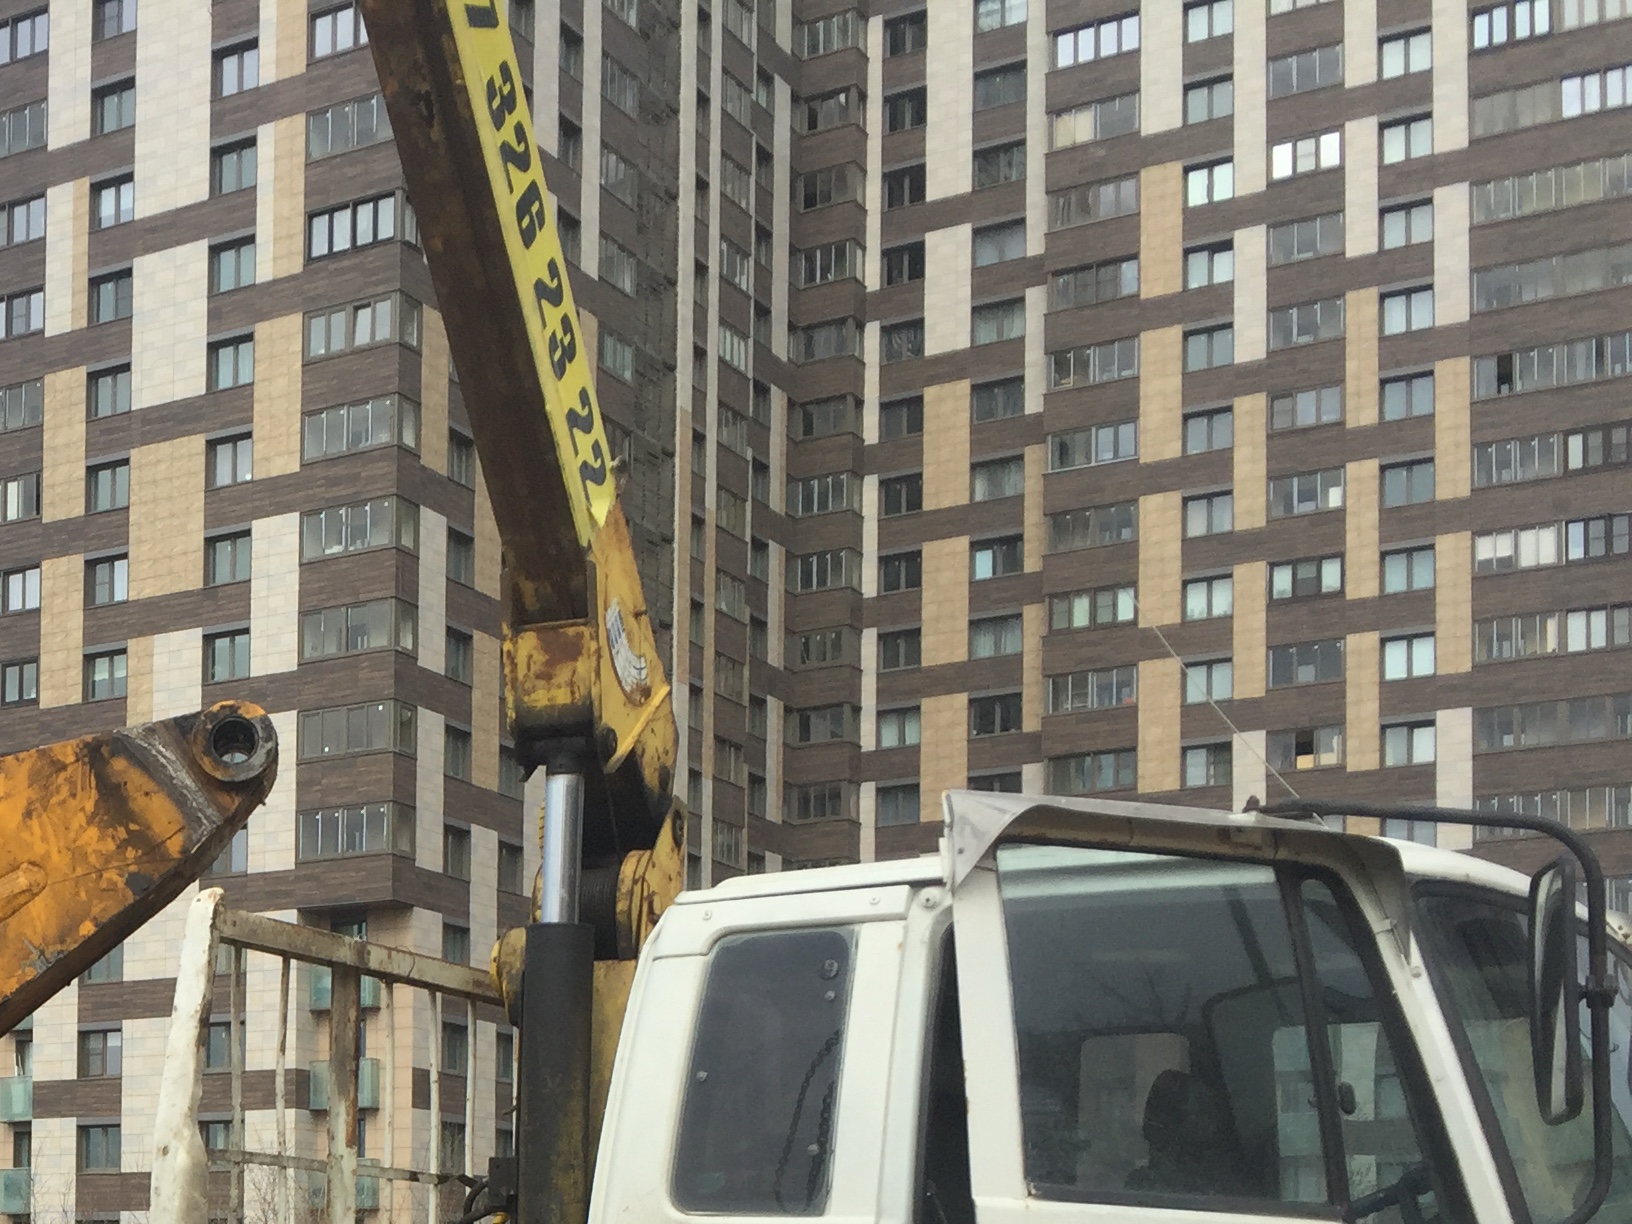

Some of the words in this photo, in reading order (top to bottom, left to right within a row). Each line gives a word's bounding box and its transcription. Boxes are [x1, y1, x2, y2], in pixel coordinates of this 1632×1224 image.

[486, 59, 546, 250] 326
[534, 257, 577, 382] 23
[566, 386, 607, 508] 22
